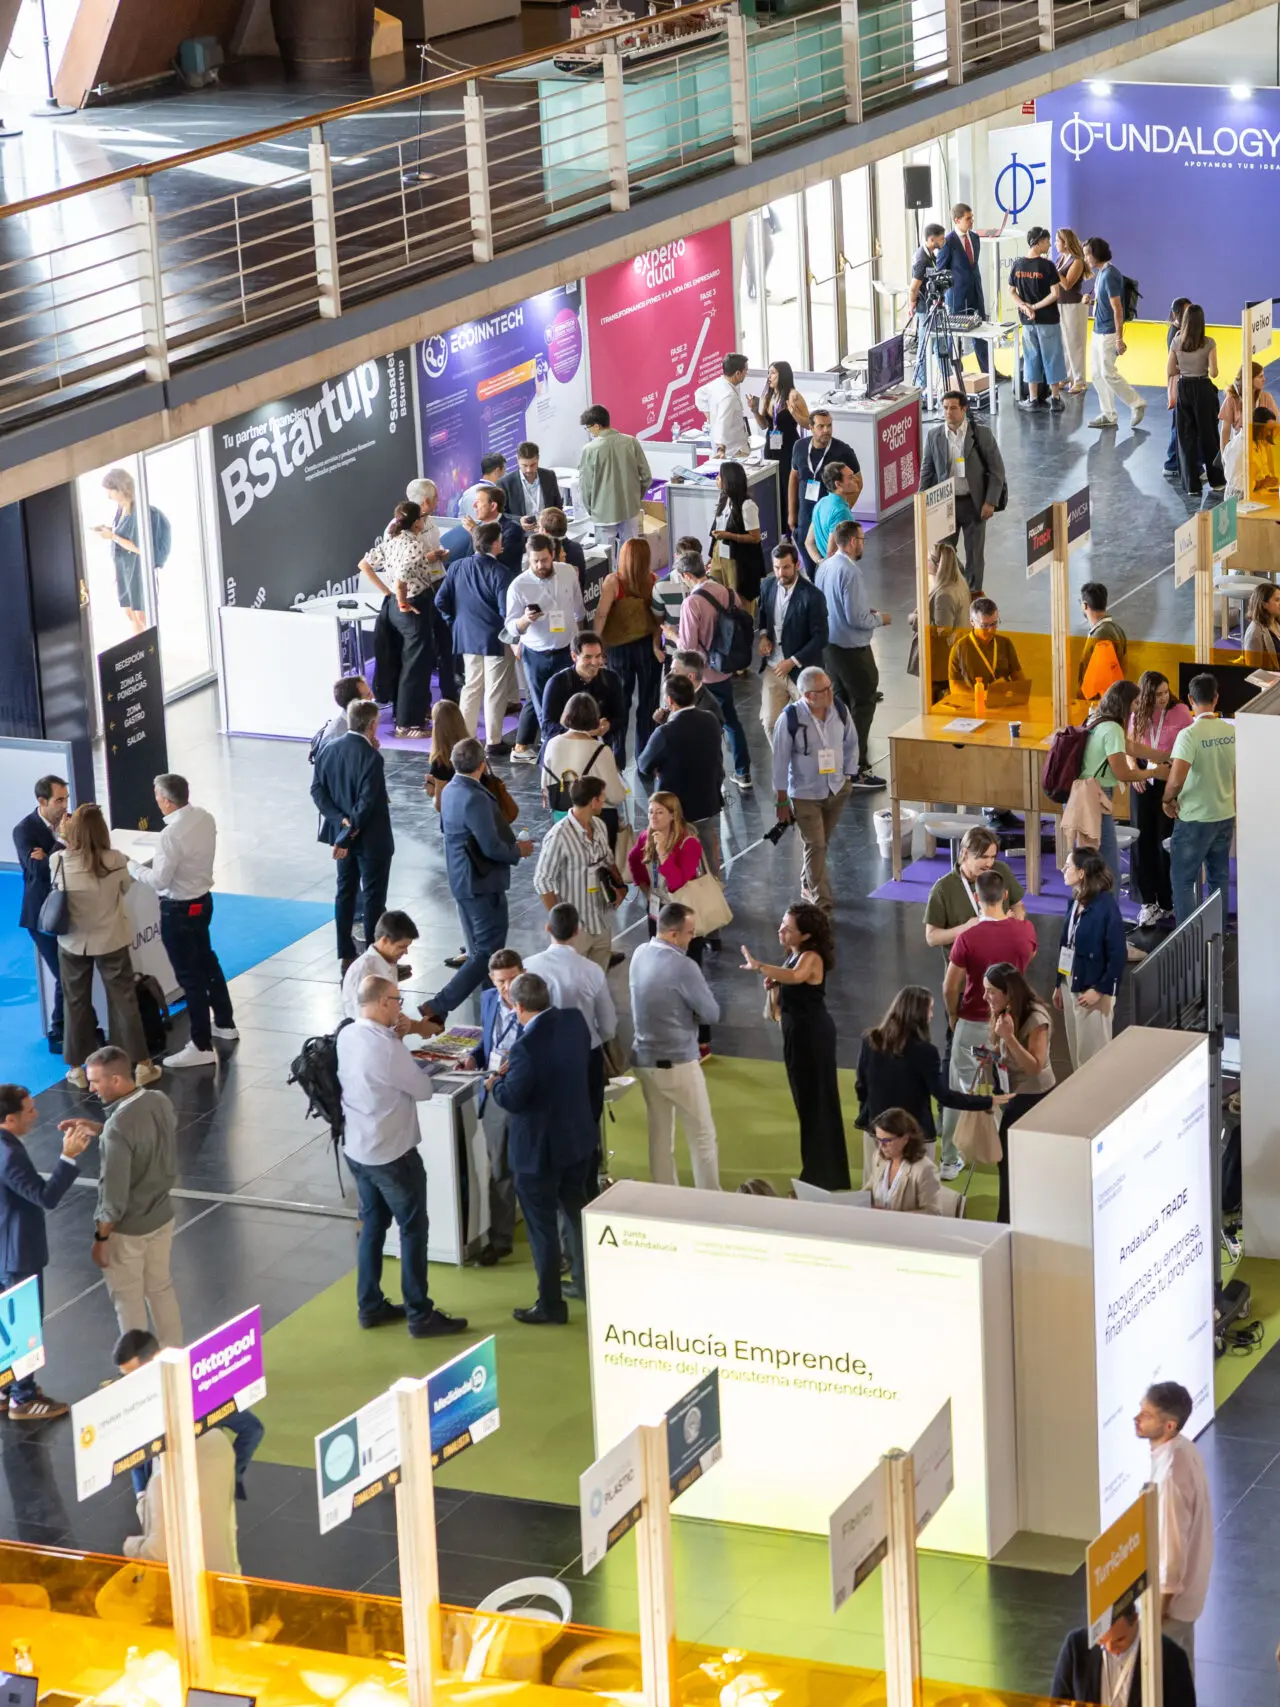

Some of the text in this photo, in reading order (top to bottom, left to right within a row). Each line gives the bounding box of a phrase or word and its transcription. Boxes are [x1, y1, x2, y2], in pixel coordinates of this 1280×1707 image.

[634, 238, 686, 276] experto
[646, 259, 675, 289] dual
[220, 358, 381, 526] BStartup
[222, 406, 310, 450] Tu partner financiero
[882, 415, 913, 442] experto
[889, 431, 906, 451] dual
[925, 482, 954, 508] ARTEMISA
[117, 680, 148, 701] PONENCIAS
[120, 671, 143, 690] ZONA DE
[124, 710, 145, 728] GASTRO
[126, 703, 142, 717] ZONA
[126, 730, 146, 747] SALIDA
[1160, 1188, 1188, 1223] TRADE
[622, 1229, 647, 1239] Junta
[1105, 1286, 1156, 1345] financiamos
[1167, 1241, 1204, 1288] proyecto
[1107, 1268, 1152, 1322] Apoyamos
[605, 1323, 874, 1381] Andalucía Emprende,
[603, 1352, 673, 1373] referente
[675, 1359, 698, 1376] del
[702, 1365, 790, 1388] eosistema
[604, 1468, 634, 1505] PLASTIC
